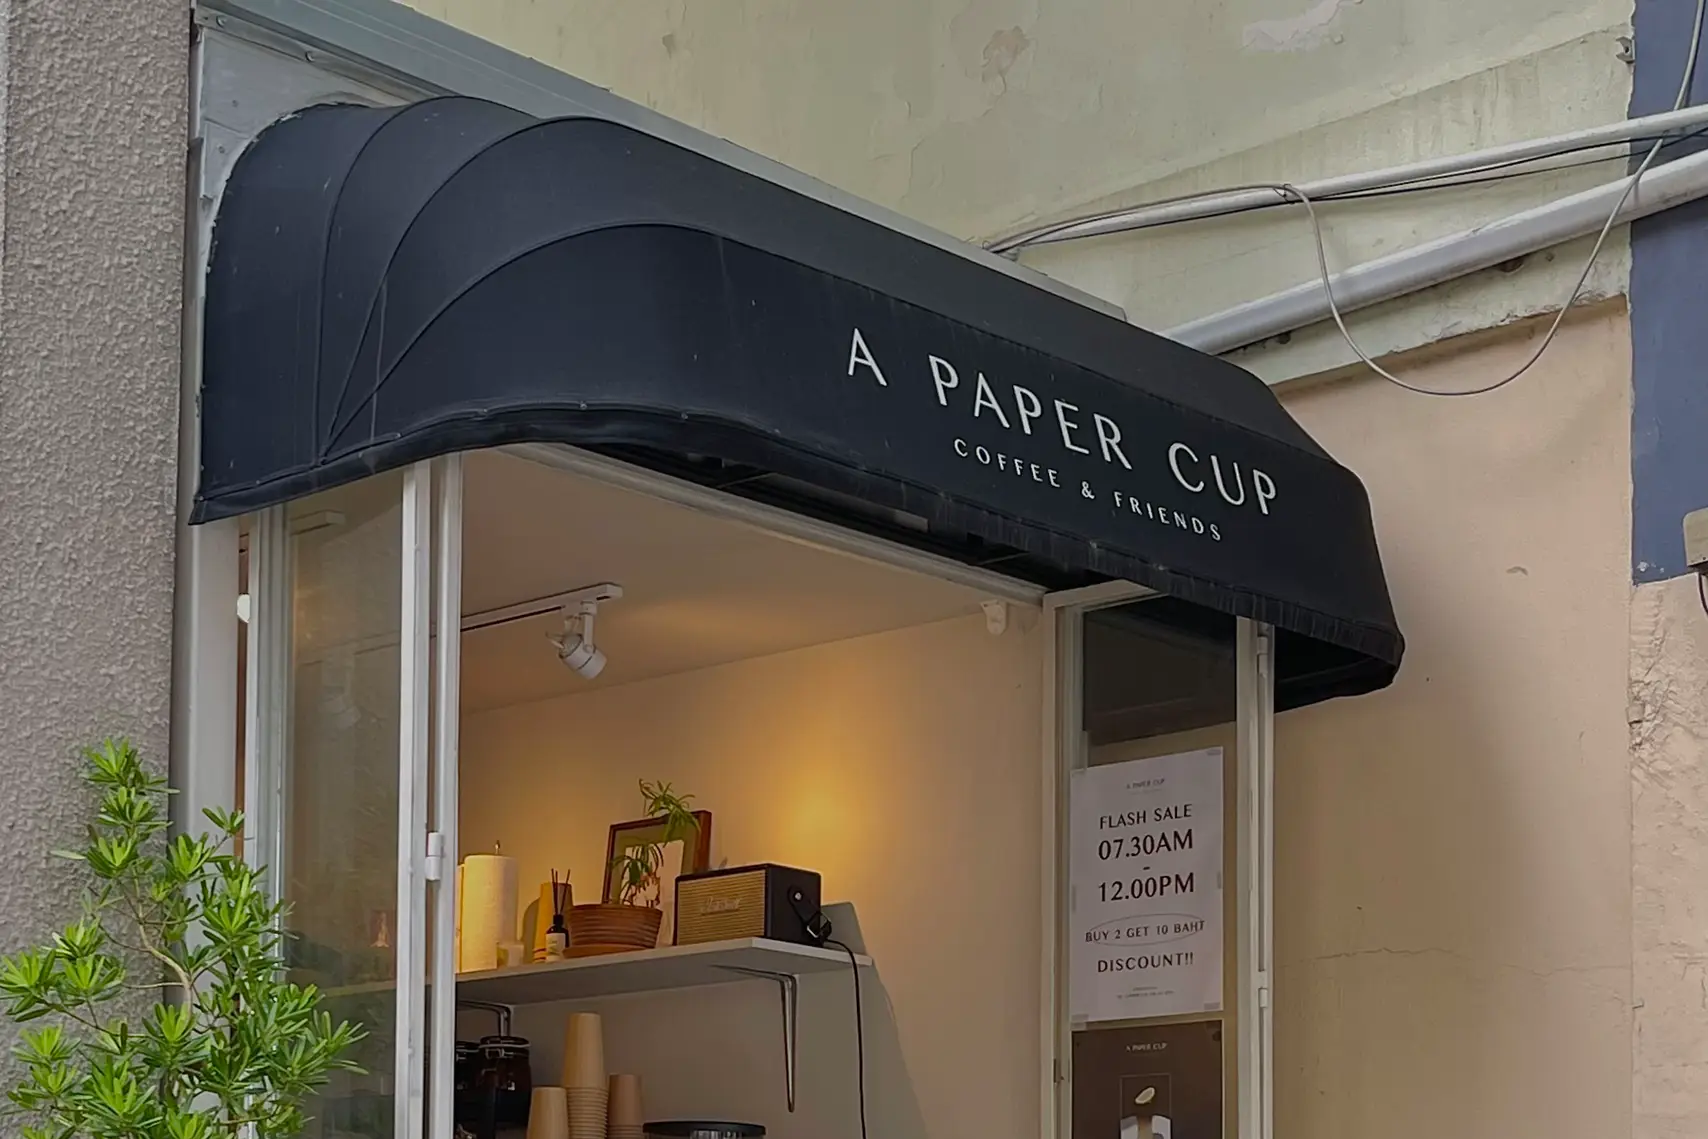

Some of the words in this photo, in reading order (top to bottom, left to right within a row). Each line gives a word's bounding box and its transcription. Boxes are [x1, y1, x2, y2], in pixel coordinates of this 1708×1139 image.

[849, 329, 886, 386] A
[929, 356, 1131, 469] PAPER
[1169, 443, 1275, 514] CUP
[955, 439, 1059, 487] COFFEE
[1082, 482, 1094, 499] &
[1115, 491, 1222, 541] FRIENDS
[1099, 810, 1147, 830] FLASH
[1153, 803, 1193, 823] SALE
[1099, 829, 1192, 860] 07.30AM
[1097, 872, 1194, 902] 12.00PM
[1086, 929, 1109, 942] BUY
[1115, 929, 1121, 940] 2
[1127, 926, 1148, 939] GET
[1156, 925, 1168, 935] 10
[1174, 920, 1205, 933] BAHT
[1097, 952, 1193, 973] DISCOUNT!!
